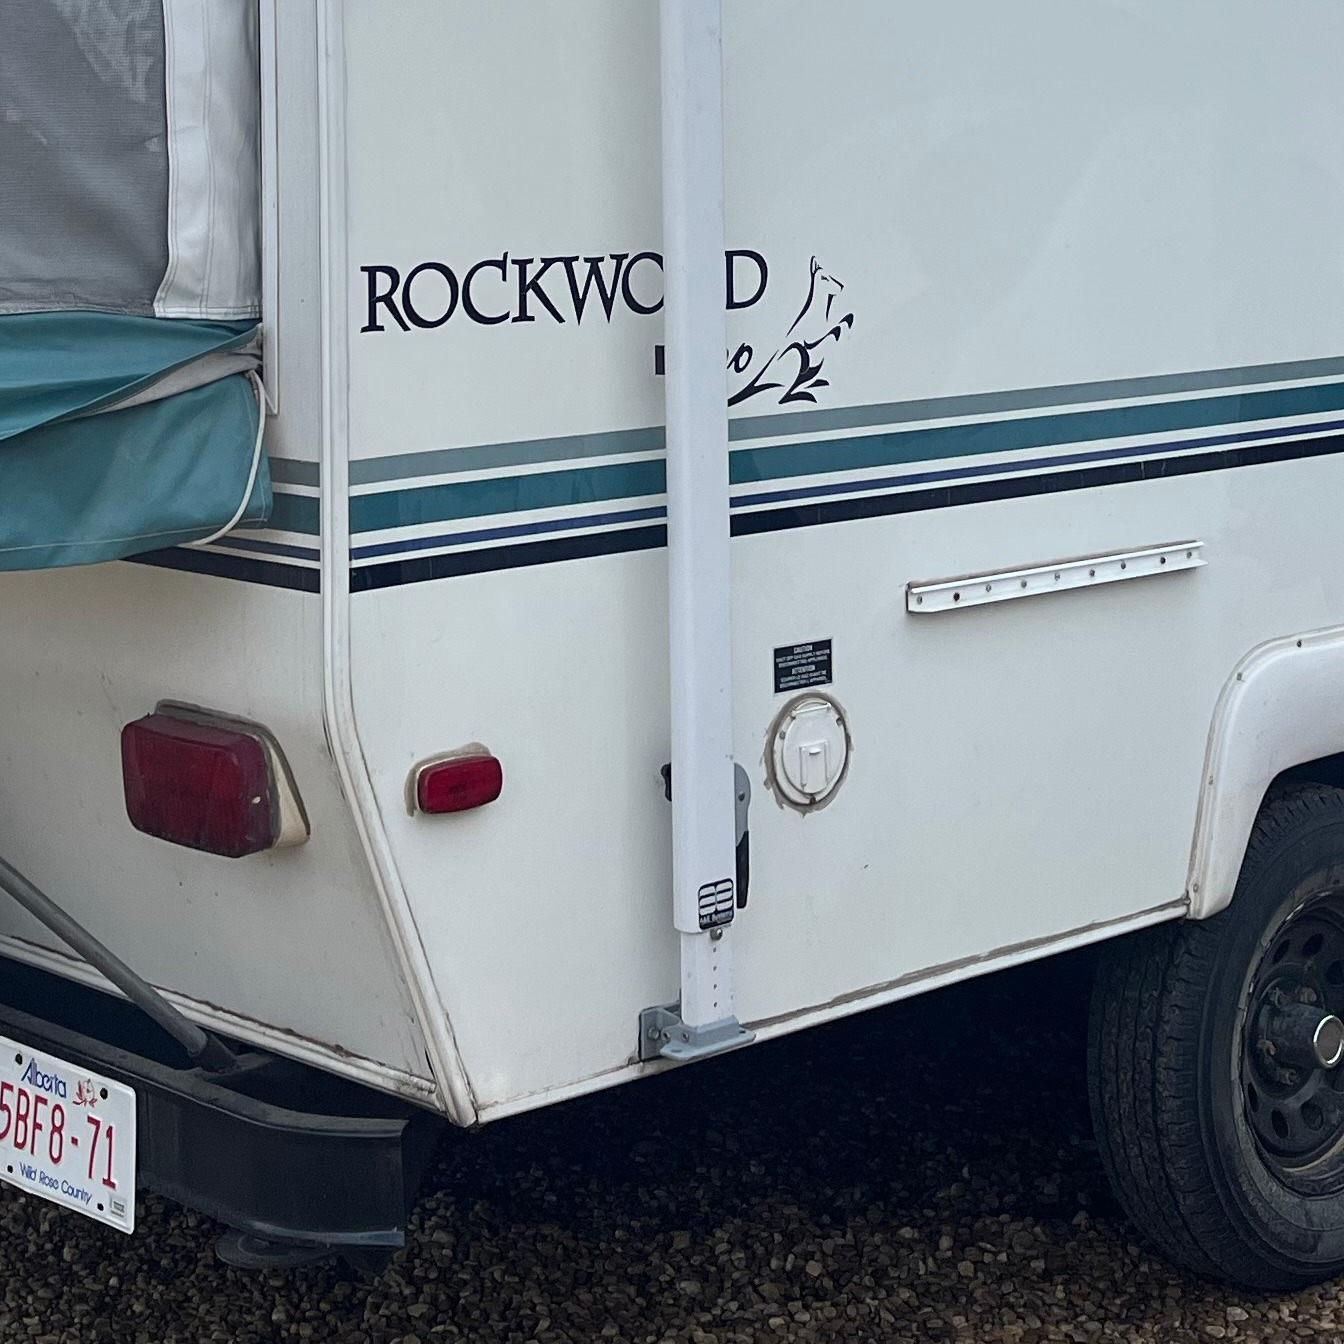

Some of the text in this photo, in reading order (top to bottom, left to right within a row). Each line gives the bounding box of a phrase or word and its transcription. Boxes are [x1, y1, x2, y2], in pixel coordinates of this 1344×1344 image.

[360, 250, 770, 333] ROCKWOD
[21, 1058, 66, 1098] Alberta
[19, 1162, 92, 1205] Wild Rose Country
